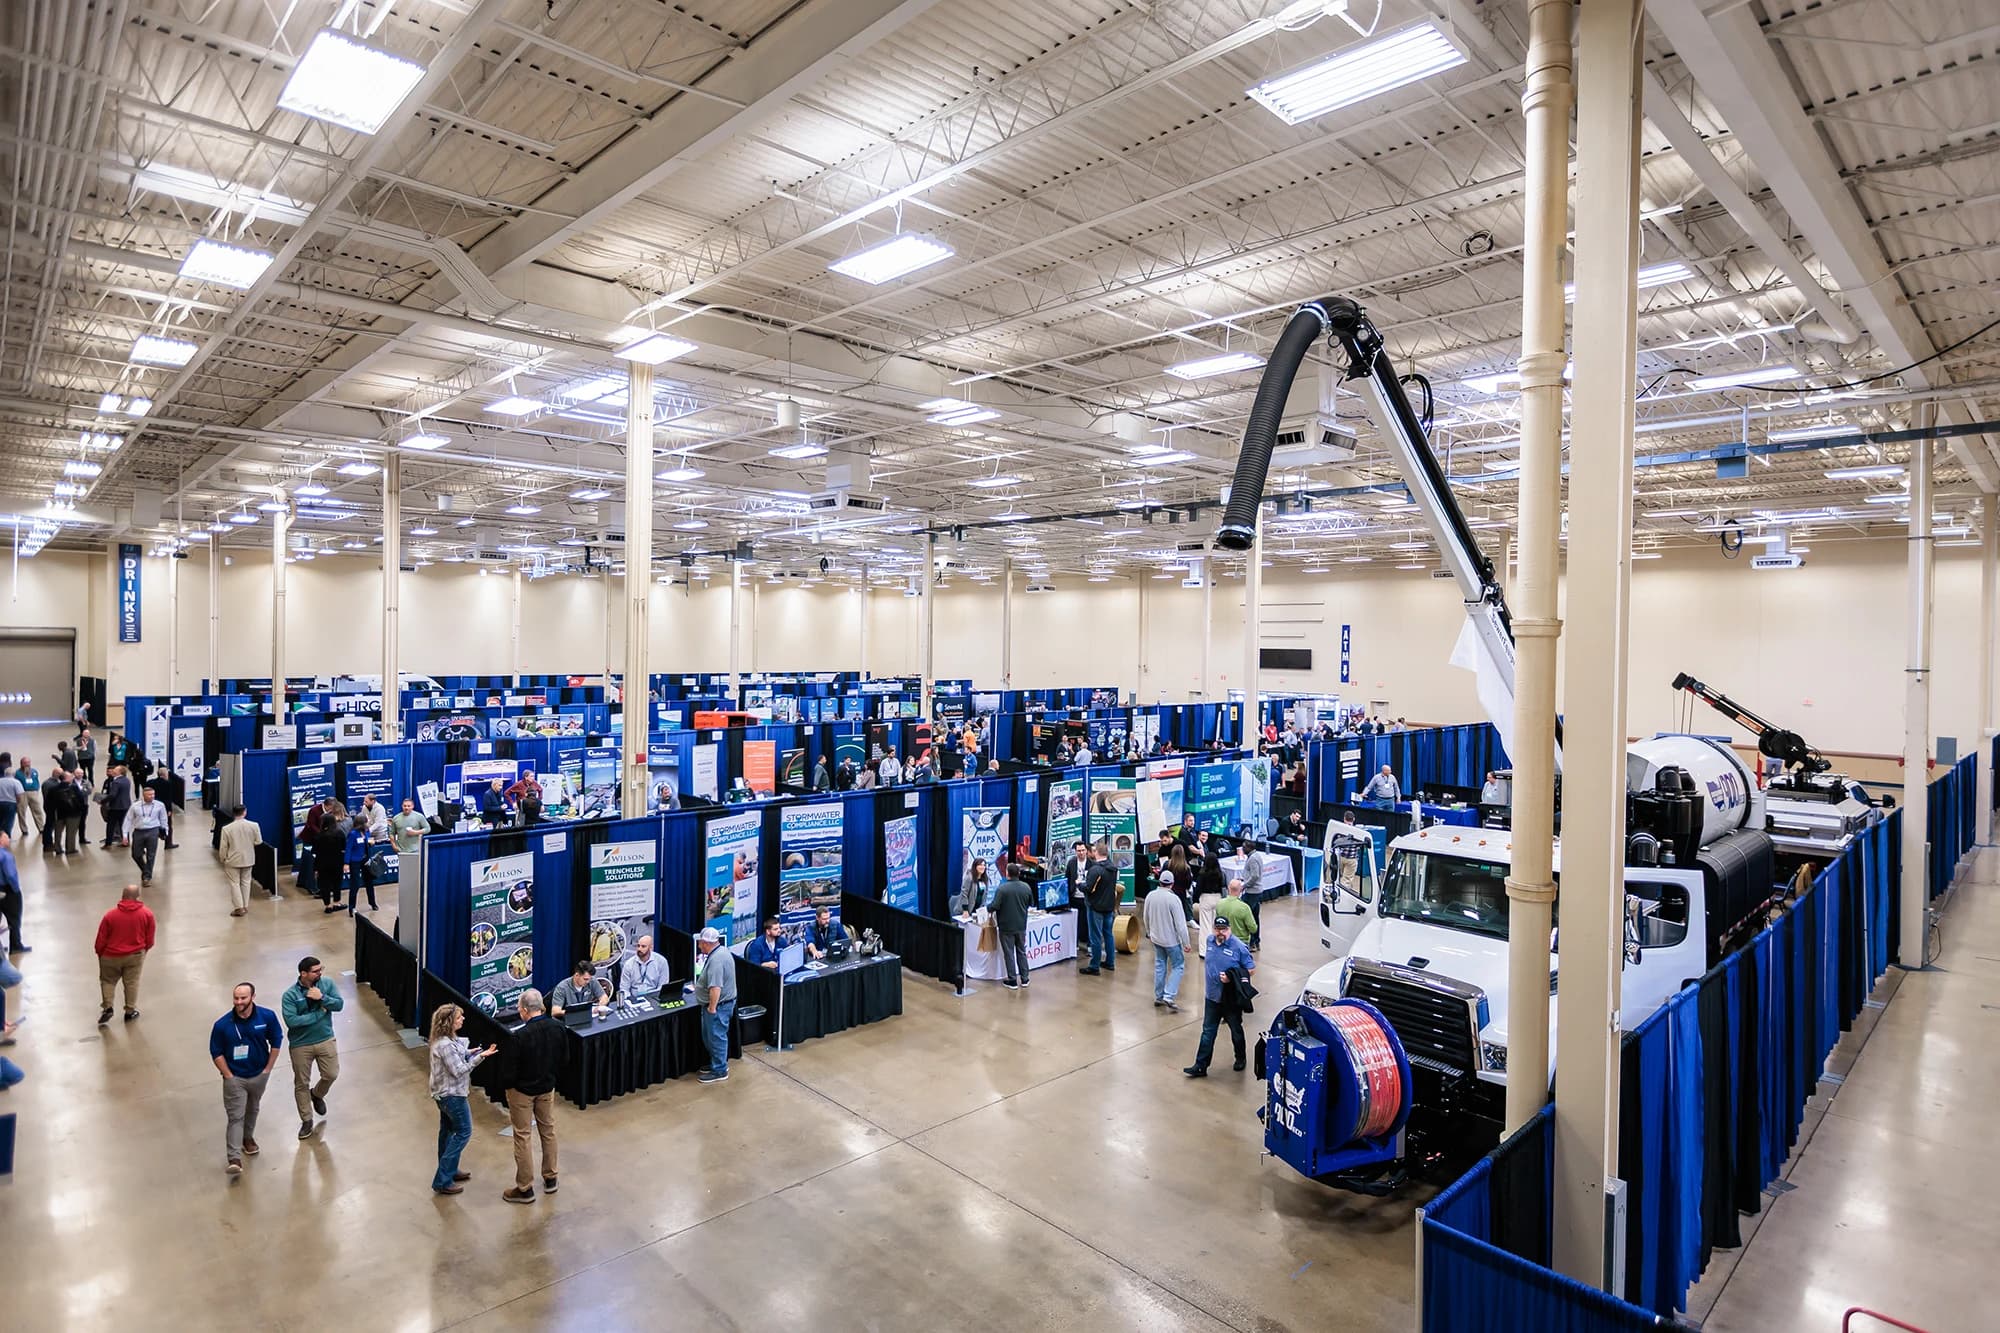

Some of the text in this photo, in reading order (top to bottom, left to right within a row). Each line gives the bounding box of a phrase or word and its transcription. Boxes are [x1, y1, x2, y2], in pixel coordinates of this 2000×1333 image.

[123, 557, 137, 623] DRINKS
[346, 700, 381, 712] HRG
[786, 810, 840, 822] STORMWATER
[711, 820, 757, 836] STORMWATER
[976, 834, 996, 843] MAPS
[611, 854, 645, 862] WILSON
[976, 848, 995, 857] APPS
[490, 868, 523, 879] WILSON
[604, 866, 646, 875] TRENCHLESS
[605, 872, 644, 881] SOLUTIONS
[1027, 923, 1061, 948] IVIC
[1026, 941, 1062, 960] APPER
